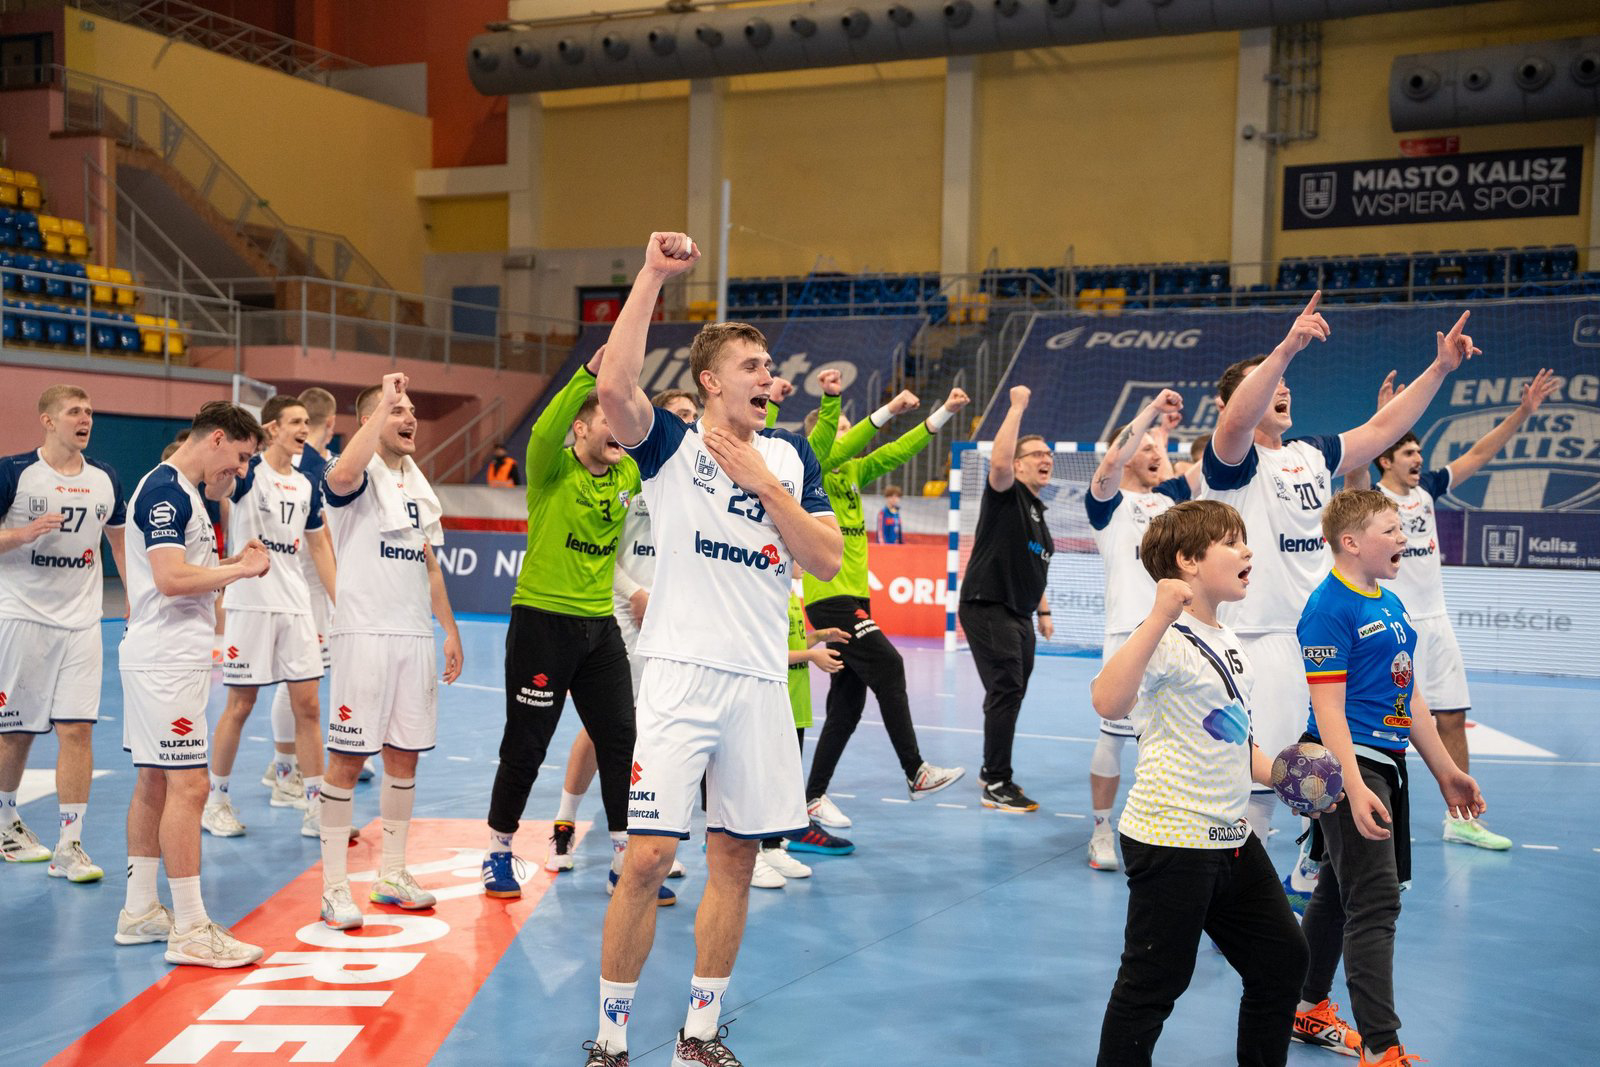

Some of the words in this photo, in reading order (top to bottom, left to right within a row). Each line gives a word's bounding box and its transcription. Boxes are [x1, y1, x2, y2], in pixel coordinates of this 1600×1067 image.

[1352, 164, 1459, 191] MIASTO
[1467, 157, 1567, 185] KALISZ
[1351, 191, 1466, 217] WSPIERA
[1473, 183, 1566, 211] SPORT
[1085, 328, 1203, 349] PGNiG
[1494, 413, 1575, 433] KS
[60, 506, 87, 533] 27
[280, 501, 295, 524] 17
[600, 500, 612, 522] 3
[694, 530, 771, 570] lenovo
[1528, 536, 1577, 553] Kalisz
[31, 549, 87, 569] lenovo
[1458, 605, 1573, 632] mieście
[1390, 621, 1406, 645] 13
[1225, 649, 1244, 675] 15
[329, 723, 363, 735] SUZUKI
[159, 738, 205, 748] SUZUKI
[145, 914, 451, 1064] ORLE
